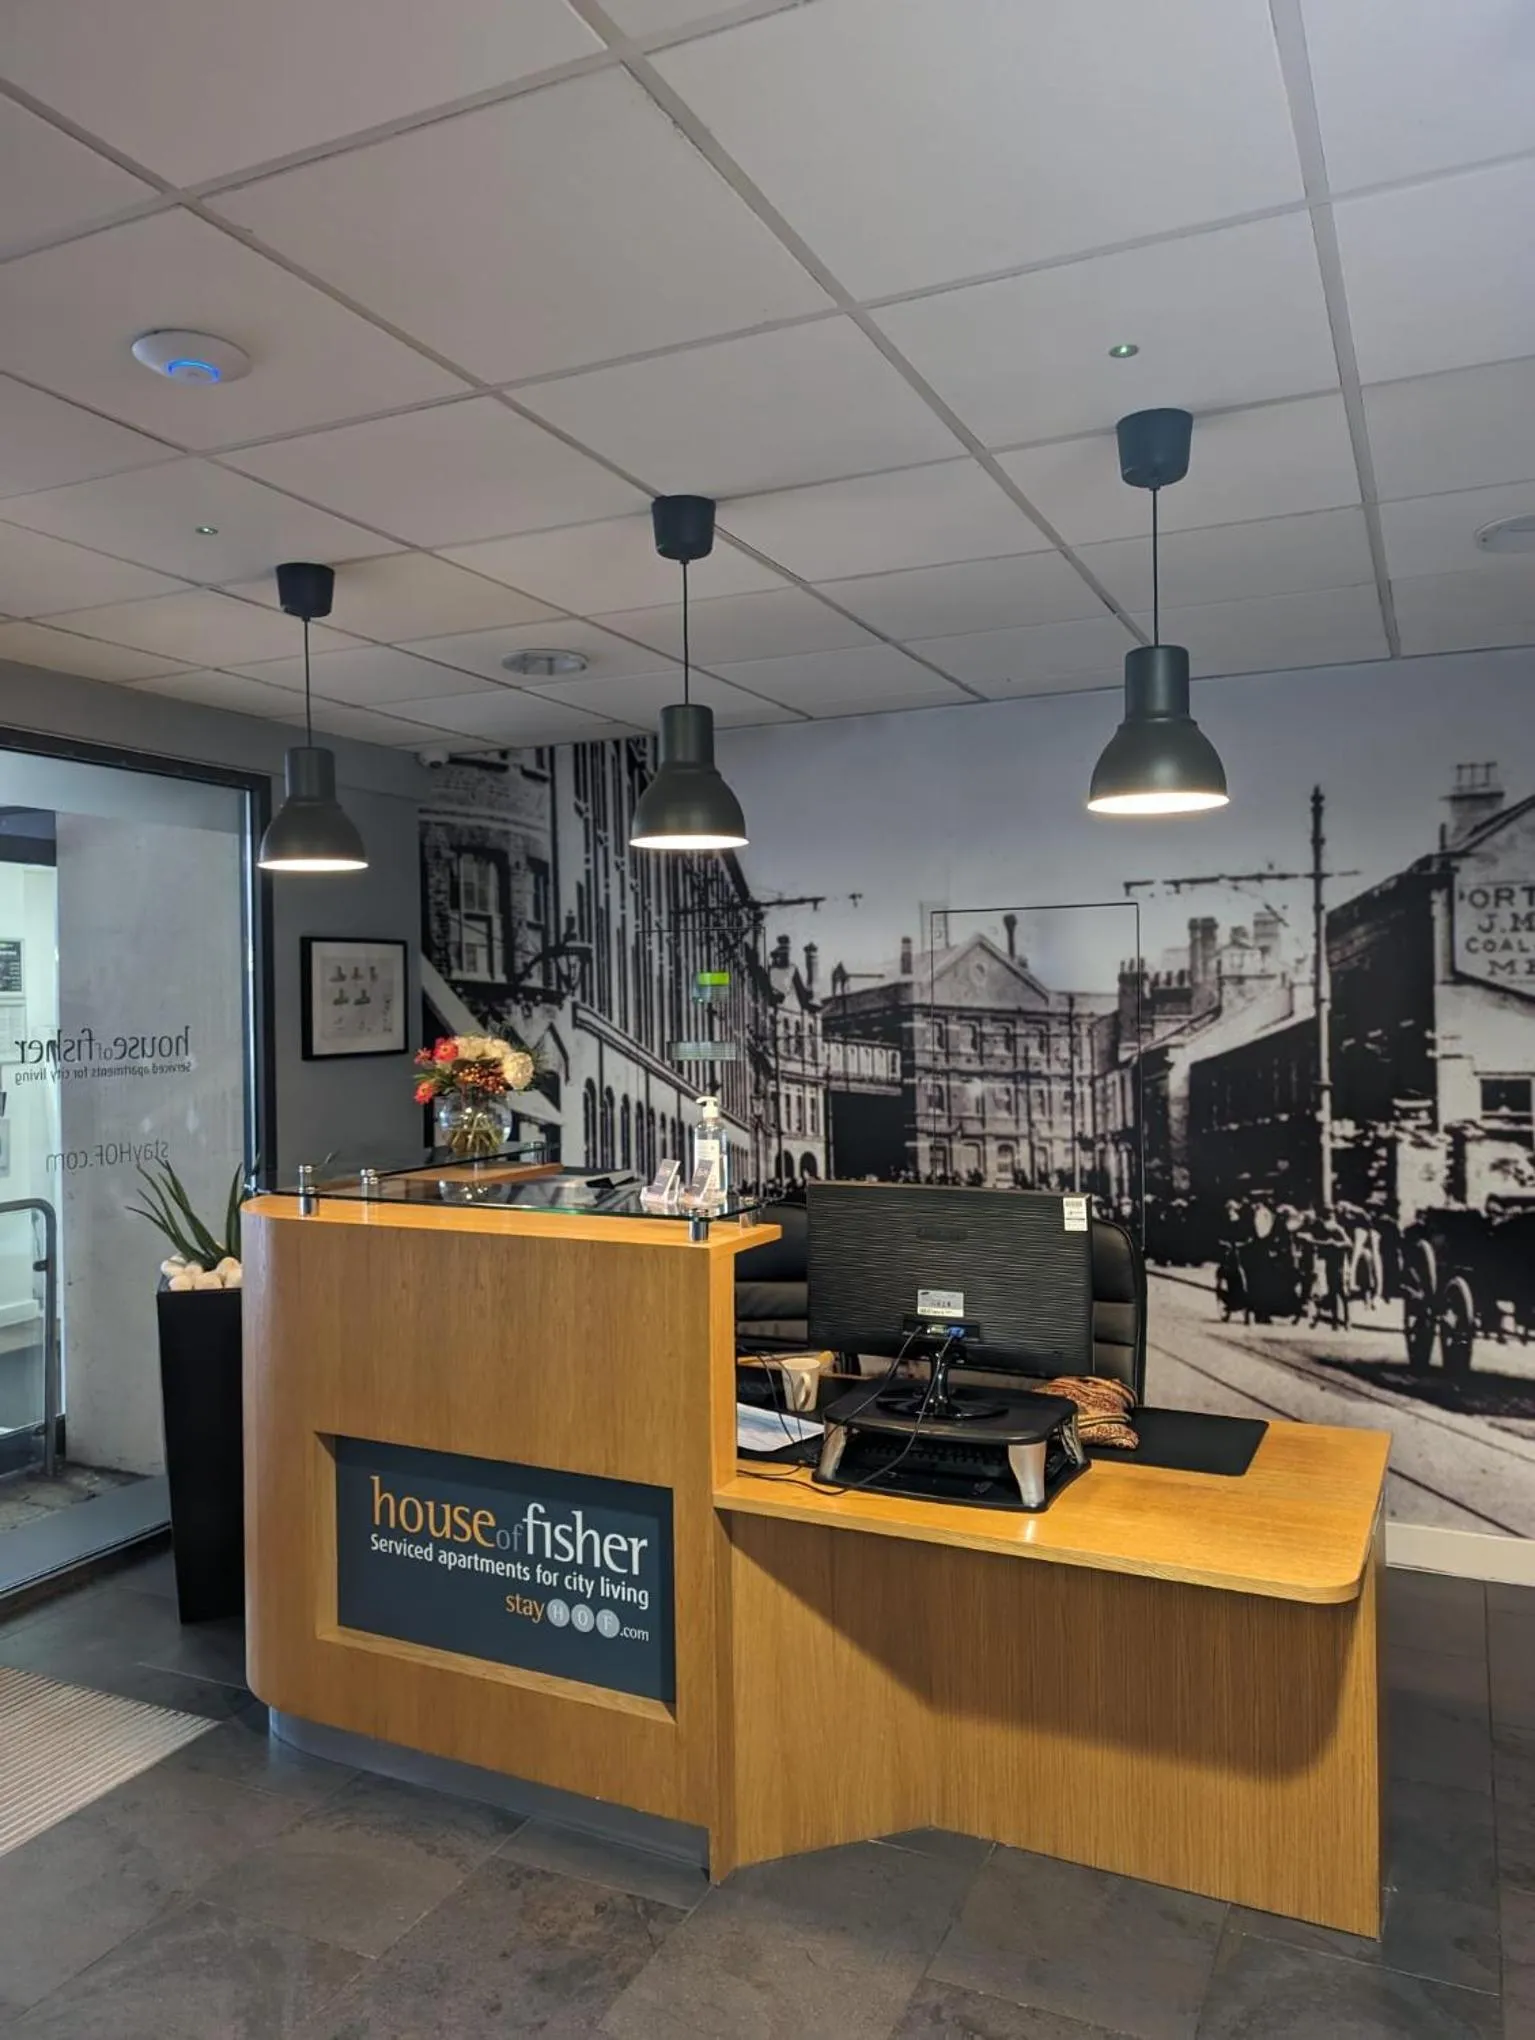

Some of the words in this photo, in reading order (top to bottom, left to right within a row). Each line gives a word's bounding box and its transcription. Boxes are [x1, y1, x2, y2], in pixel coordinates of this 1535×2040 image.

[369, 1475, 496, 1549] house
[496, 1523, 523, 1551] of
[522, 1502, 648, 1576] fisher
[371, 1532, 433, 1562] Serviced
[438, 1547, 531, 1582] apartments
[536, 1564, 559, 1588] for
[564, 1572, 595, 1598] city
[600, 1577, 650, 1611] living
